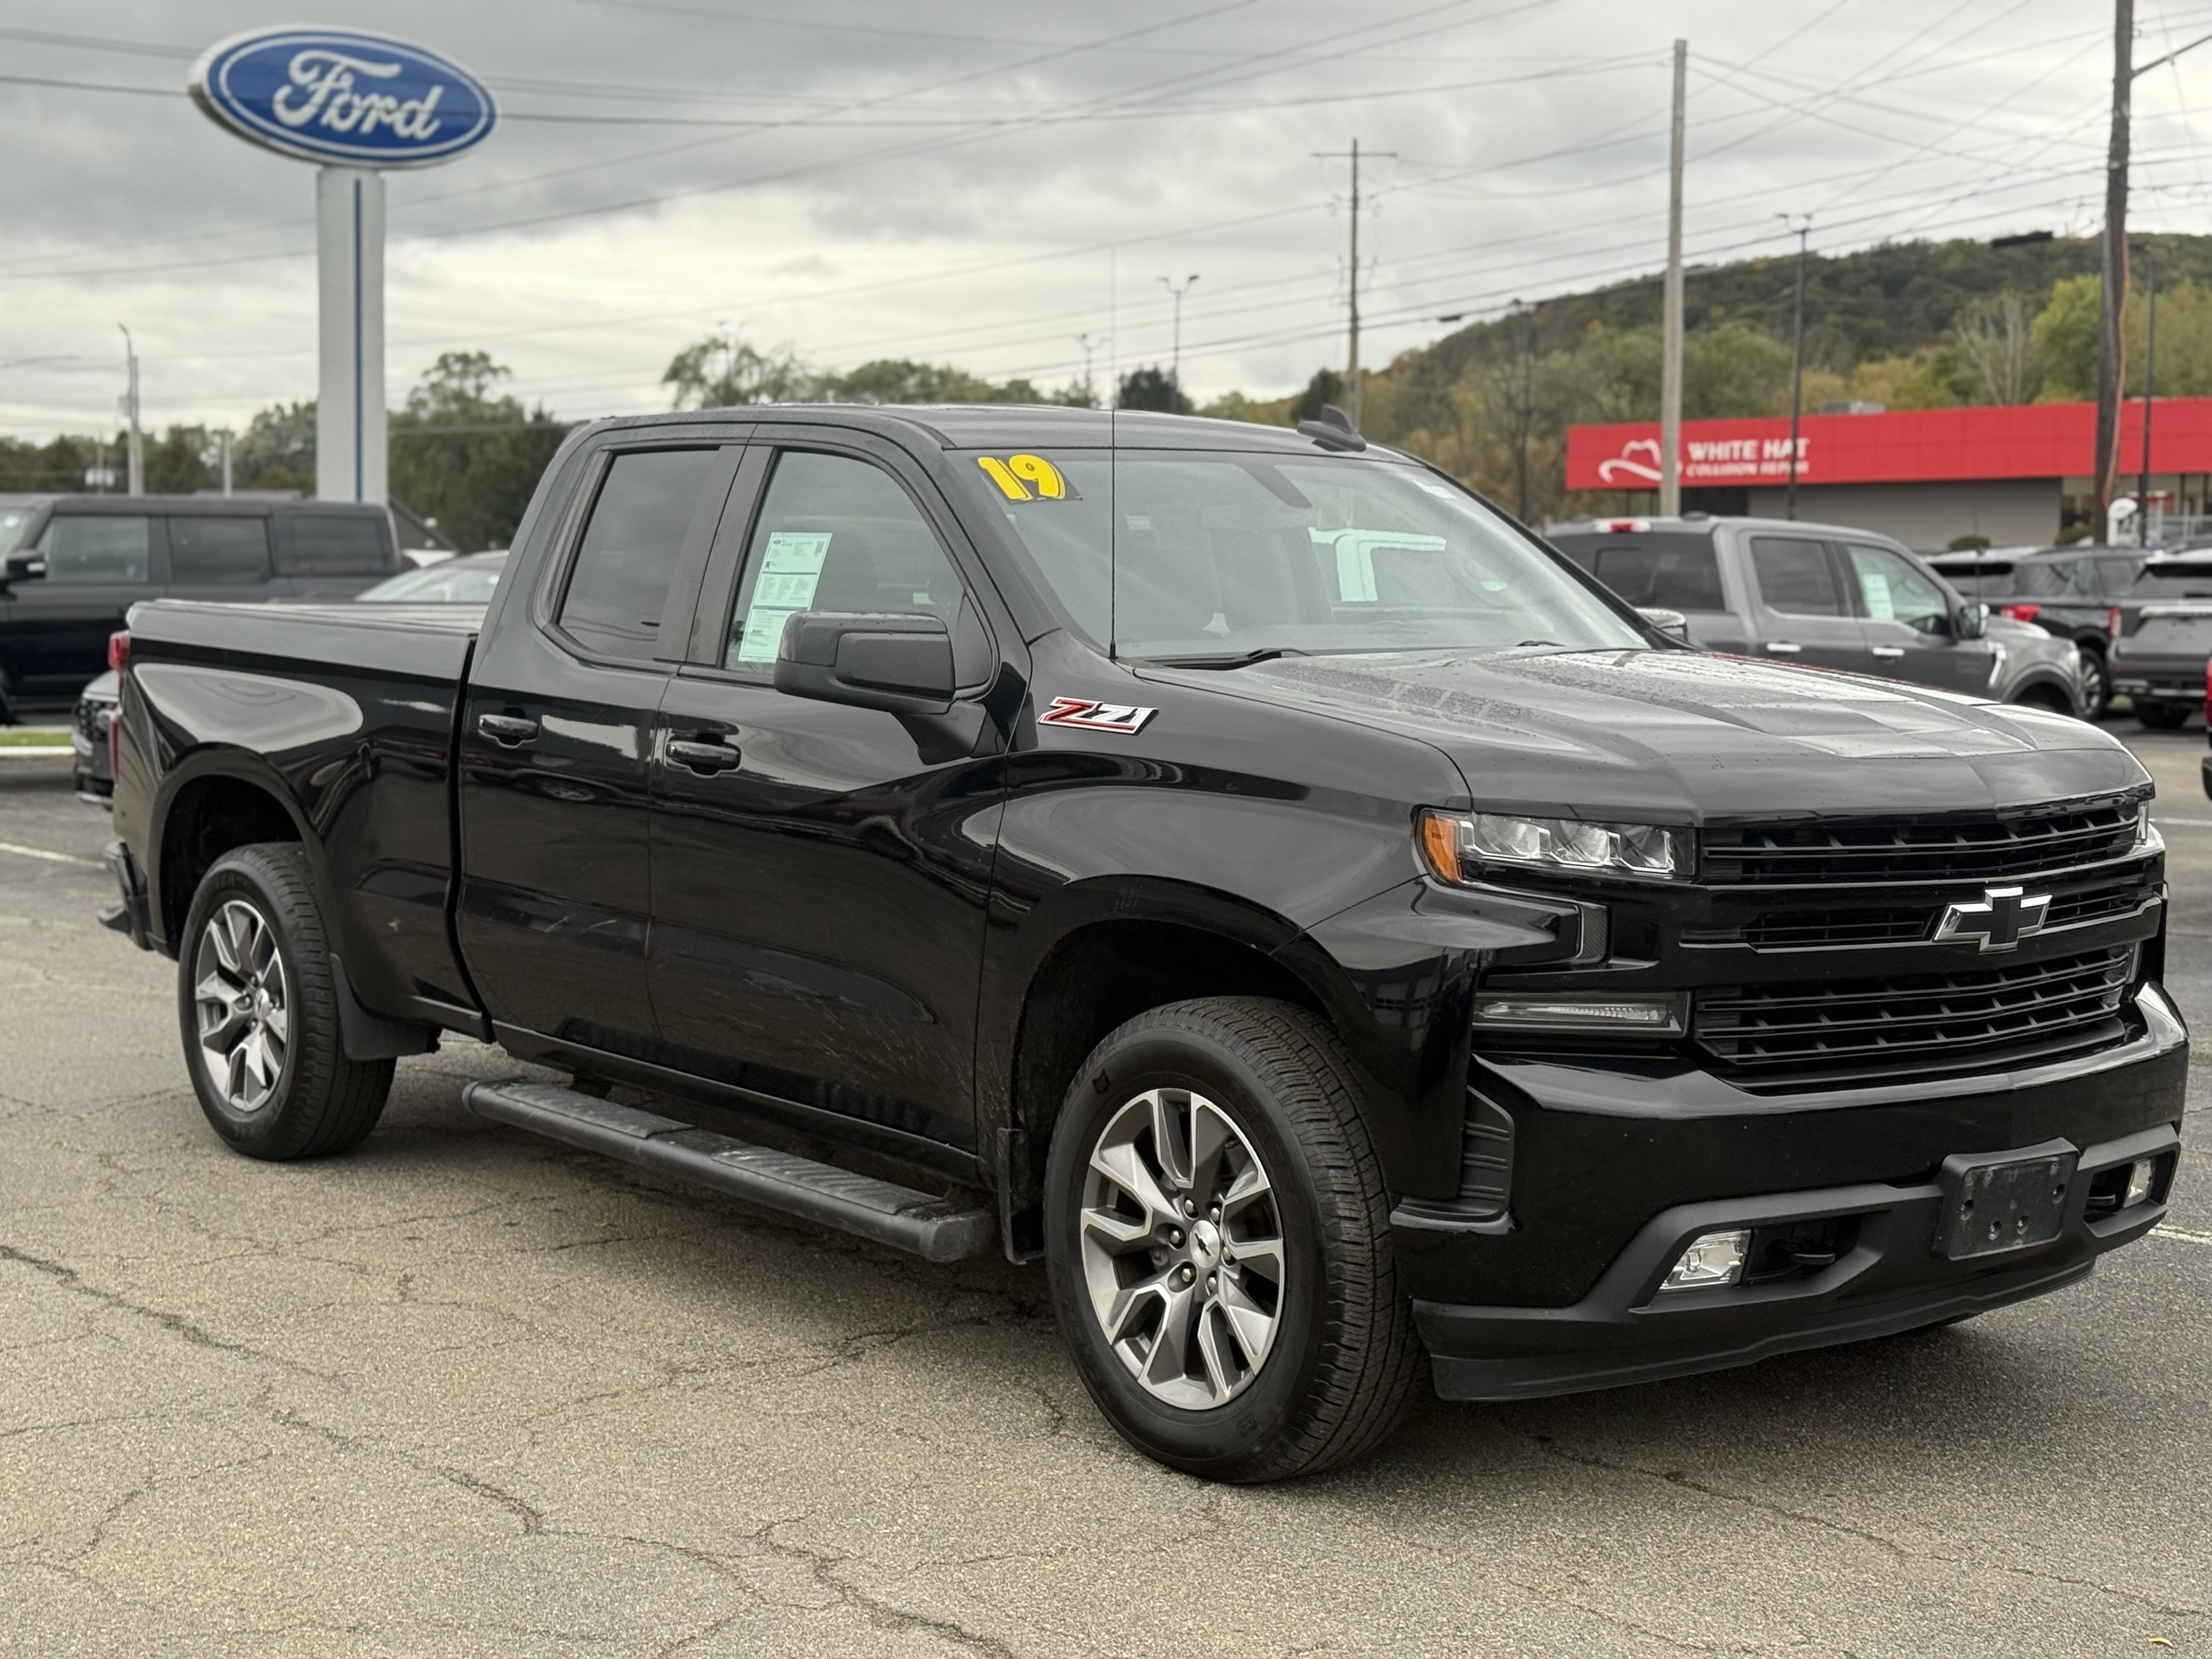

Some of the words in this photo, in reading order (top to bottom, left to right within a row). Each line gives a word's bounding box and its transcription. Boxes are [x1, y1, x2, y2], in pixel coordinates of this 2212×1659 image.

[273, 50, 443, 140] Ford
[1687, 439, 1758, 461] WHITE
[1762, 437, 1810, 459] HAT
[978, 454, 1066, 500] 19
[1037, 696, 1159, 735] Z71
